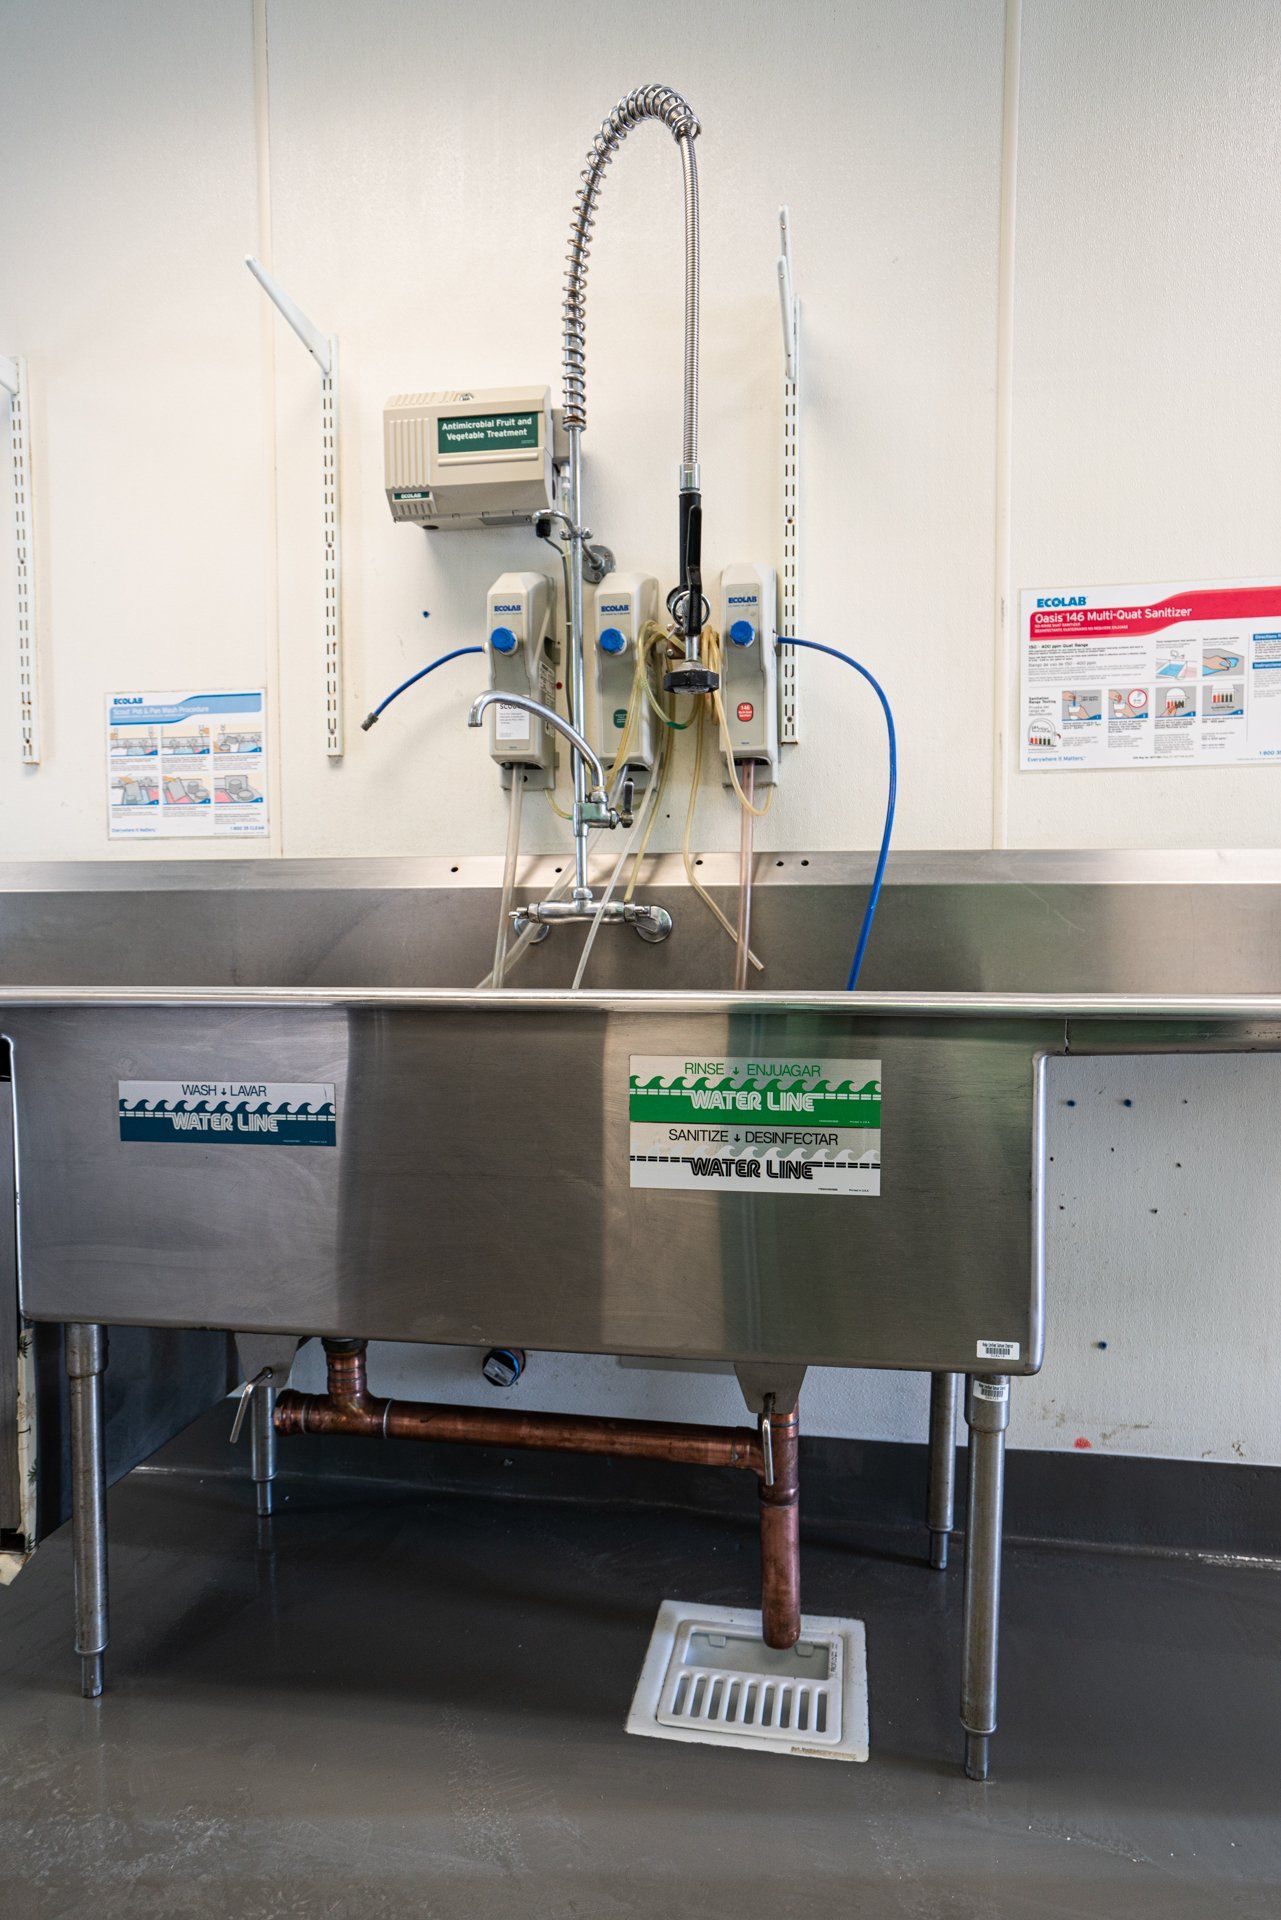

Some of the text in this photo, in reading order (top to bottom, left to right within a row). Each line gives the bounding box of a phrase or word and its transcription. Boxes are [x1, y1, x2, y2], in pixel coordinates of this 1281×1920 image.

[442, 417, 532, 430] Antimicrobial Fruit and
[446, 428, 527, 441] Vegetable Treatment
[728, 596, 758, 604] ECOLAB
[1037, 597, 1087, 608] ECOLAB
[1066, 612, 1085, 622] 146
[1087, 609, 1142, 621] Multi-Quat
[1145, 608, 1192, 619] Sanitizer
[685, 1063, 821, 1077] RINSE ENJUAGAR
[182, 1084, 267, 1096] WASH LAVAR
[690, 1090, 815, 1112] WATER LINE
[172, 1112, 279, 1132] WATER LINE
[668, 1129, 838, 1146] SANITIZE DESINFECTAR
[690, 1157, 814, 1180] WATER LINE
